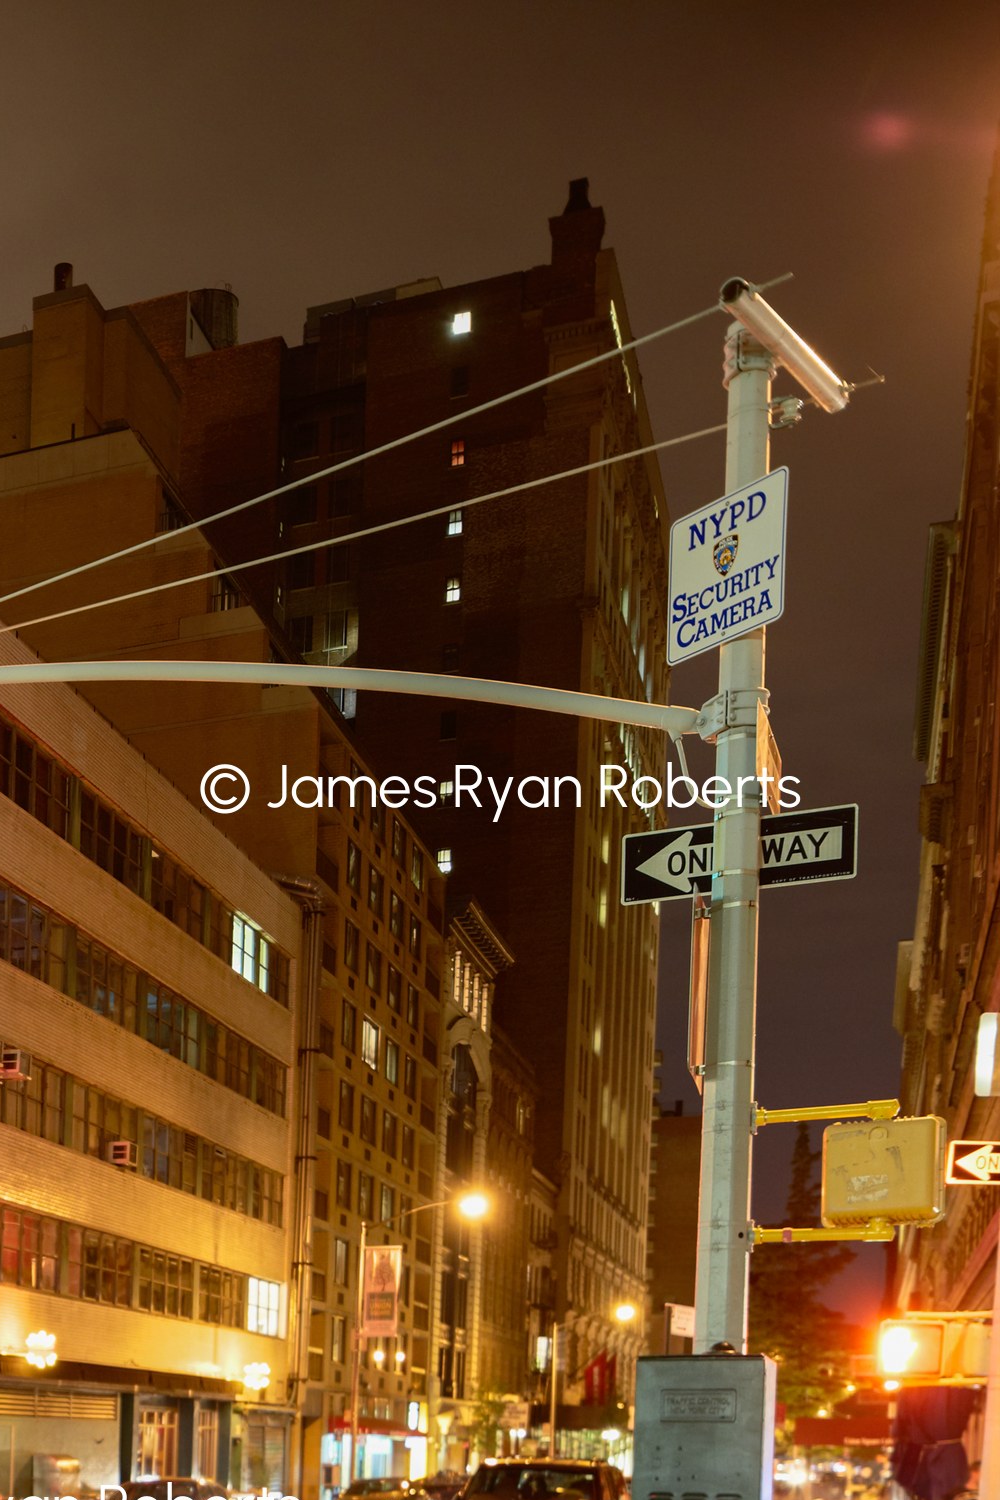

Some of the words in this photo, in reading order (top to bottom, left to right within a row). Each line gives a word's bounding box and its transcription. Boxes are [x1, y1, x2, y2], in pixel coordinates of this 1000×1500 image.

[687, 491, 767, 551] NYPD
[672, 555, 780, 624] SECURITY
[676, 589, 773, 648] CAMERA
[667, 847, 714, 876] ON
[762, 831, 829, 865] WAY
[976, 1155, 1000, 1170] ON
